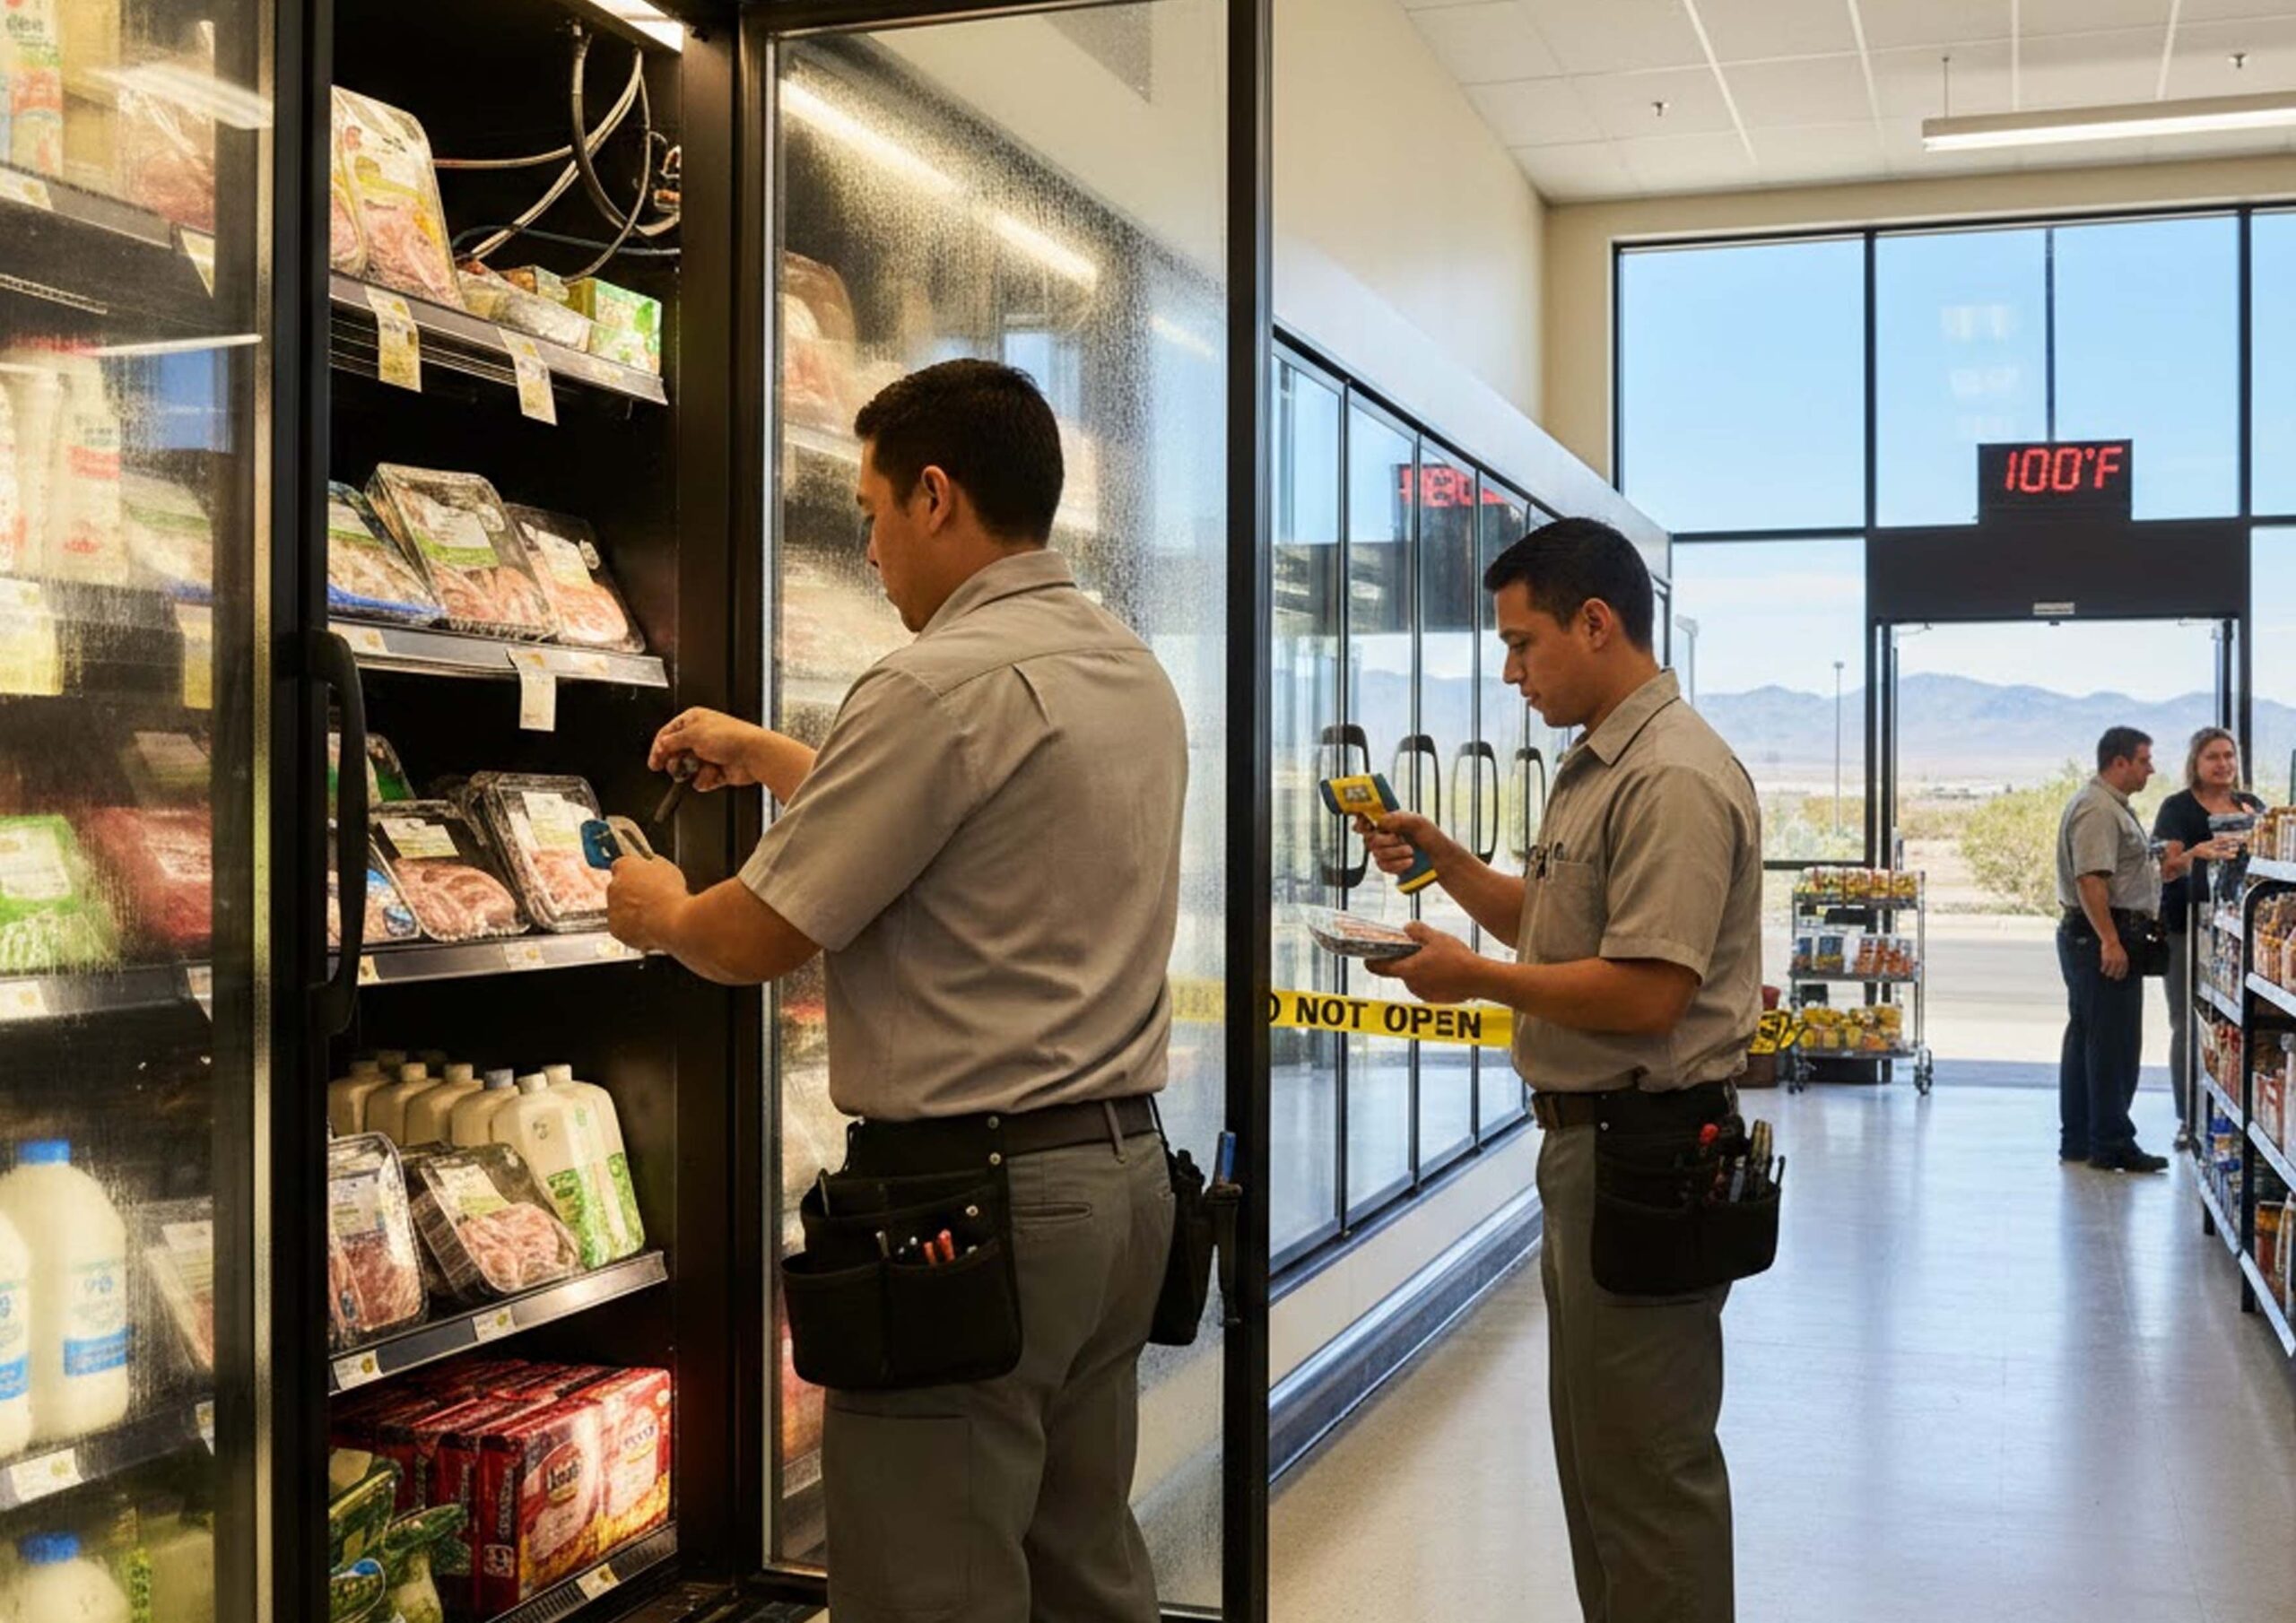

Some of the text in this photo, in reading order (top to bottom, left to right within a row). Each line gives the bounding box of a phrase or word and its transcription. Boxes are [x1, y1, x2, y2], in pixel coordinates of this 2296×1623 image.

[2005, 447, 2123, 492] 100°F
[1295, 996, 1369, 1029] NOT
[1384, 1004, 1481, 1038] OPEN
